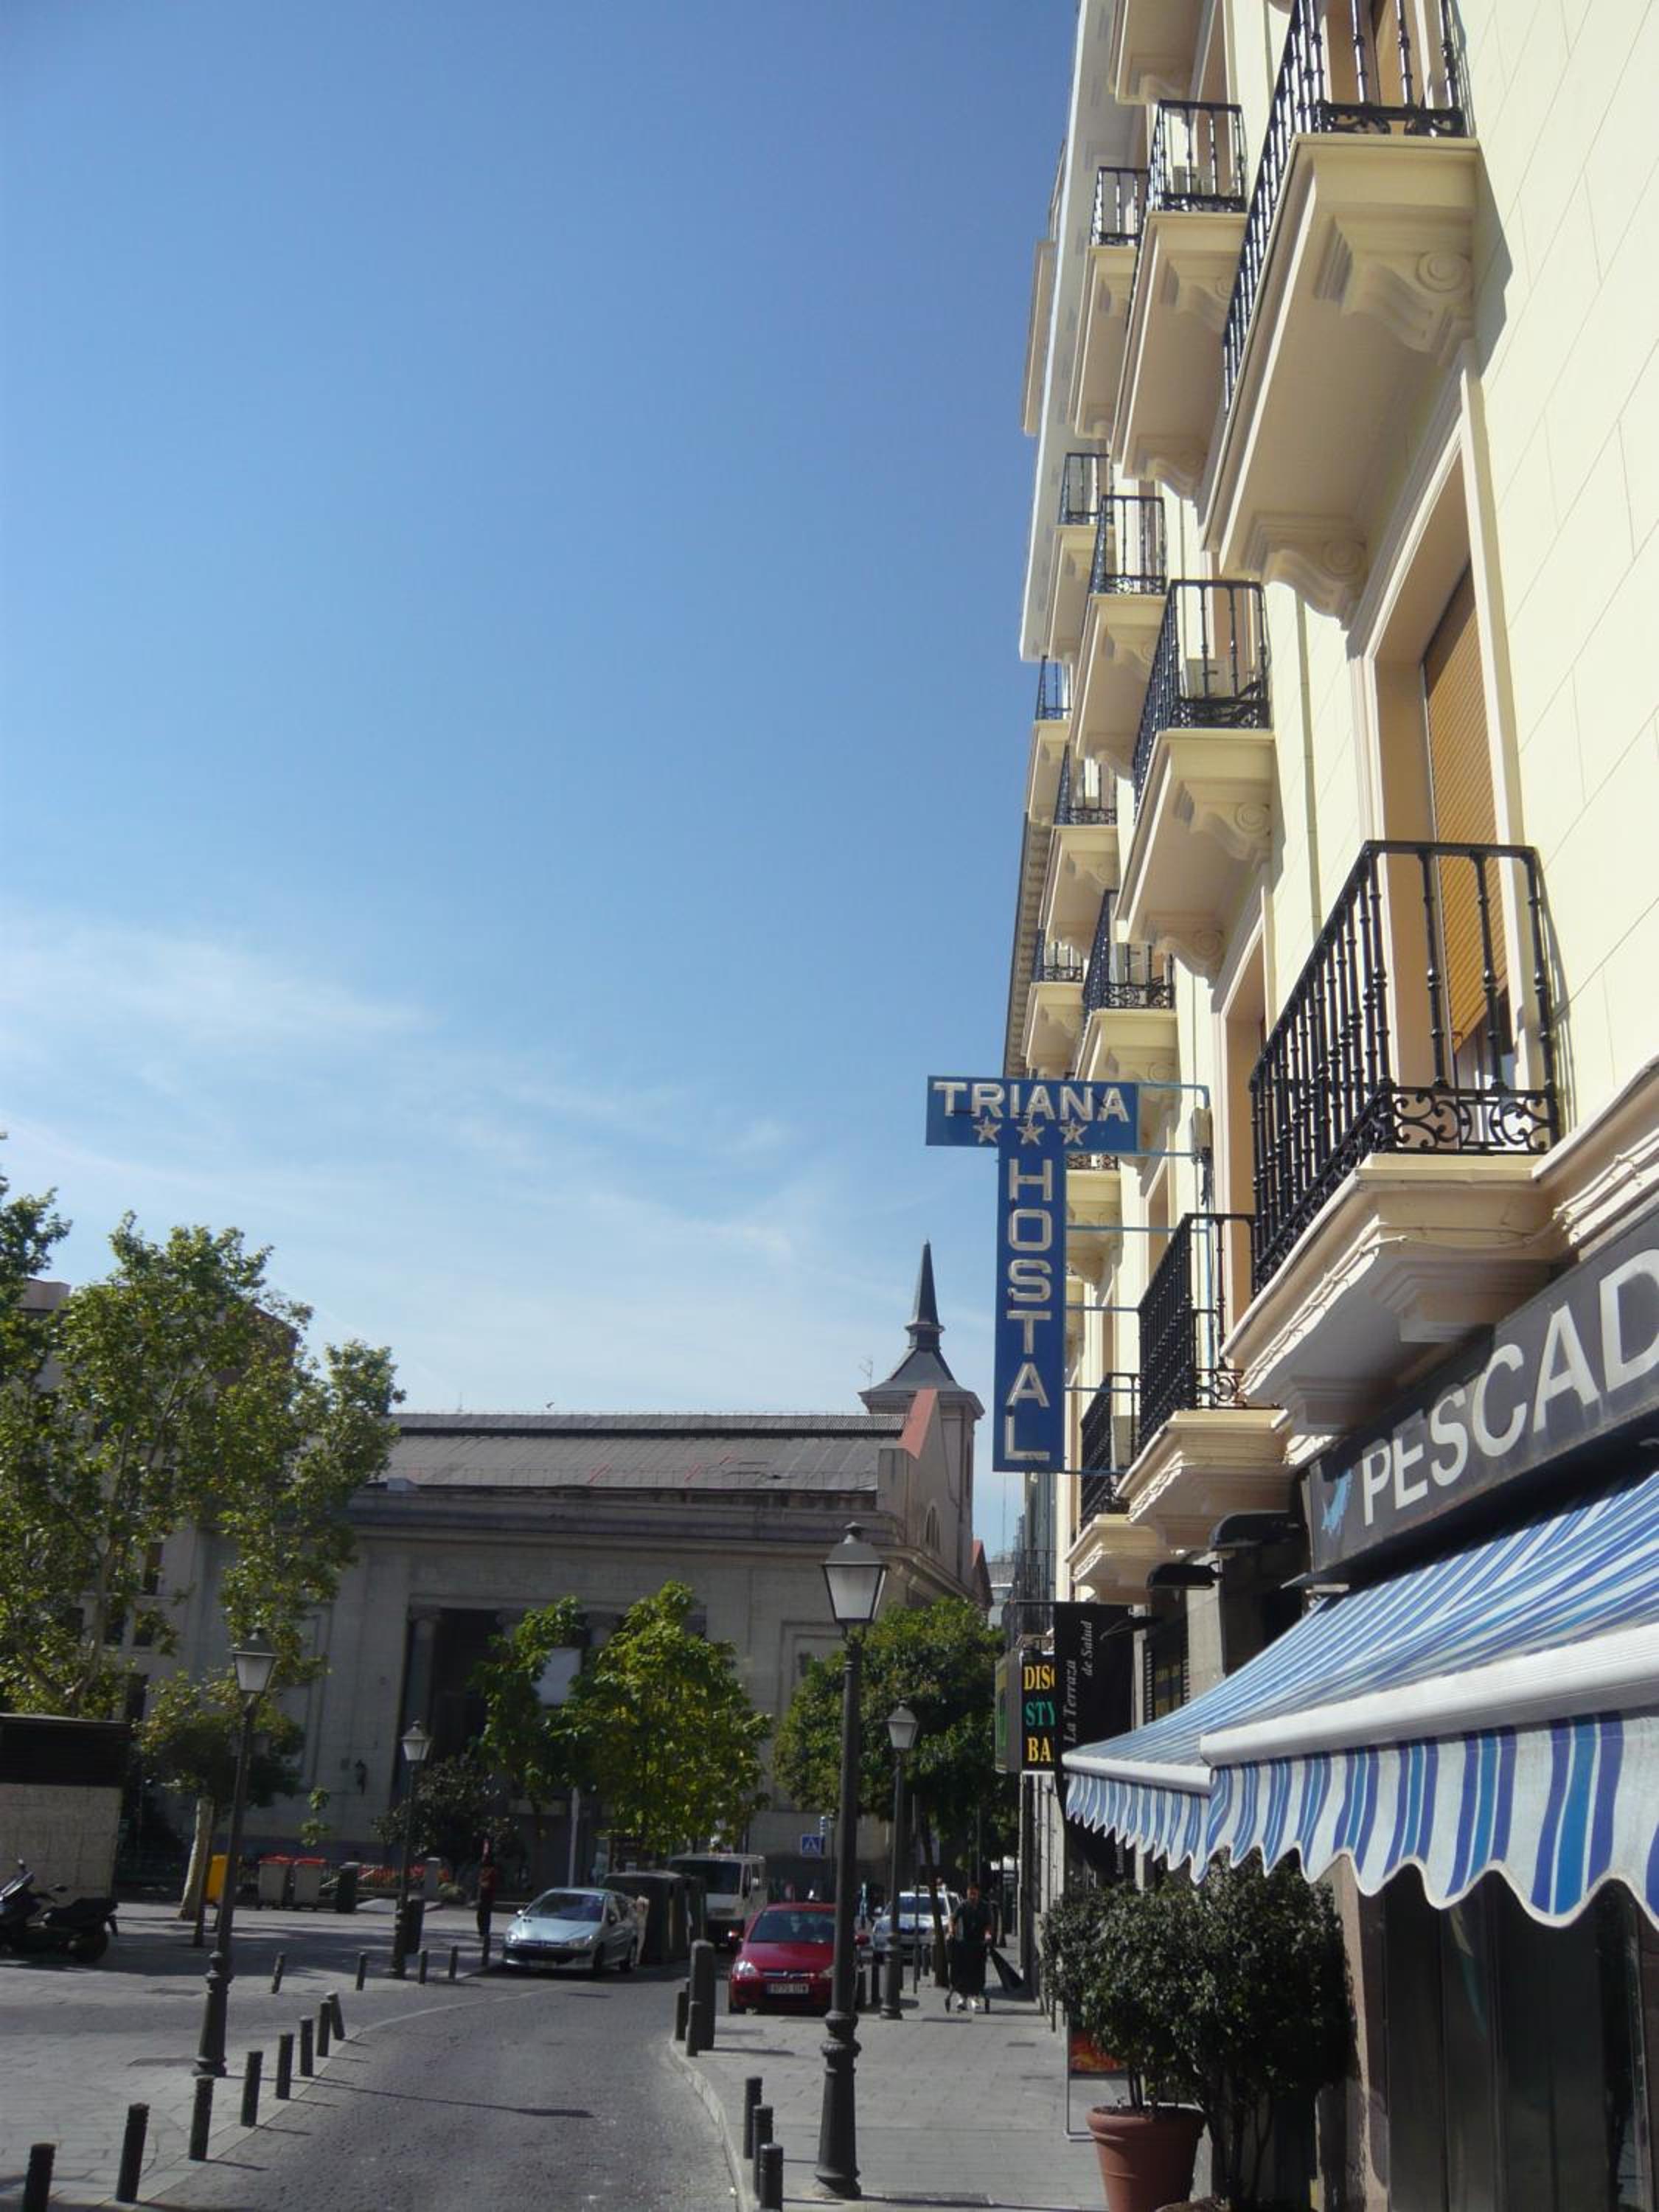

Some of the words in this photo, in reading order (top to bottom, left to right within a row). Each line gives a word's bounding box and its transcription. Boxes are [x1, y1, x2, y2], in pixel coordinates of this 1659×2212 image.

[933, 1082, 1130, 1122] TRIANA
[1004, 1158, 1053, 1461] HOSTAL
[1361, 1248, 1659, 1526] PESCAD
[1080, 1620, 1093, 1659] Salud
[1062, 1659, 1077, 1717] Terraza
[1081, 1661, 1093, 1676] de
[1063, 1720, 1077, 1743] La
